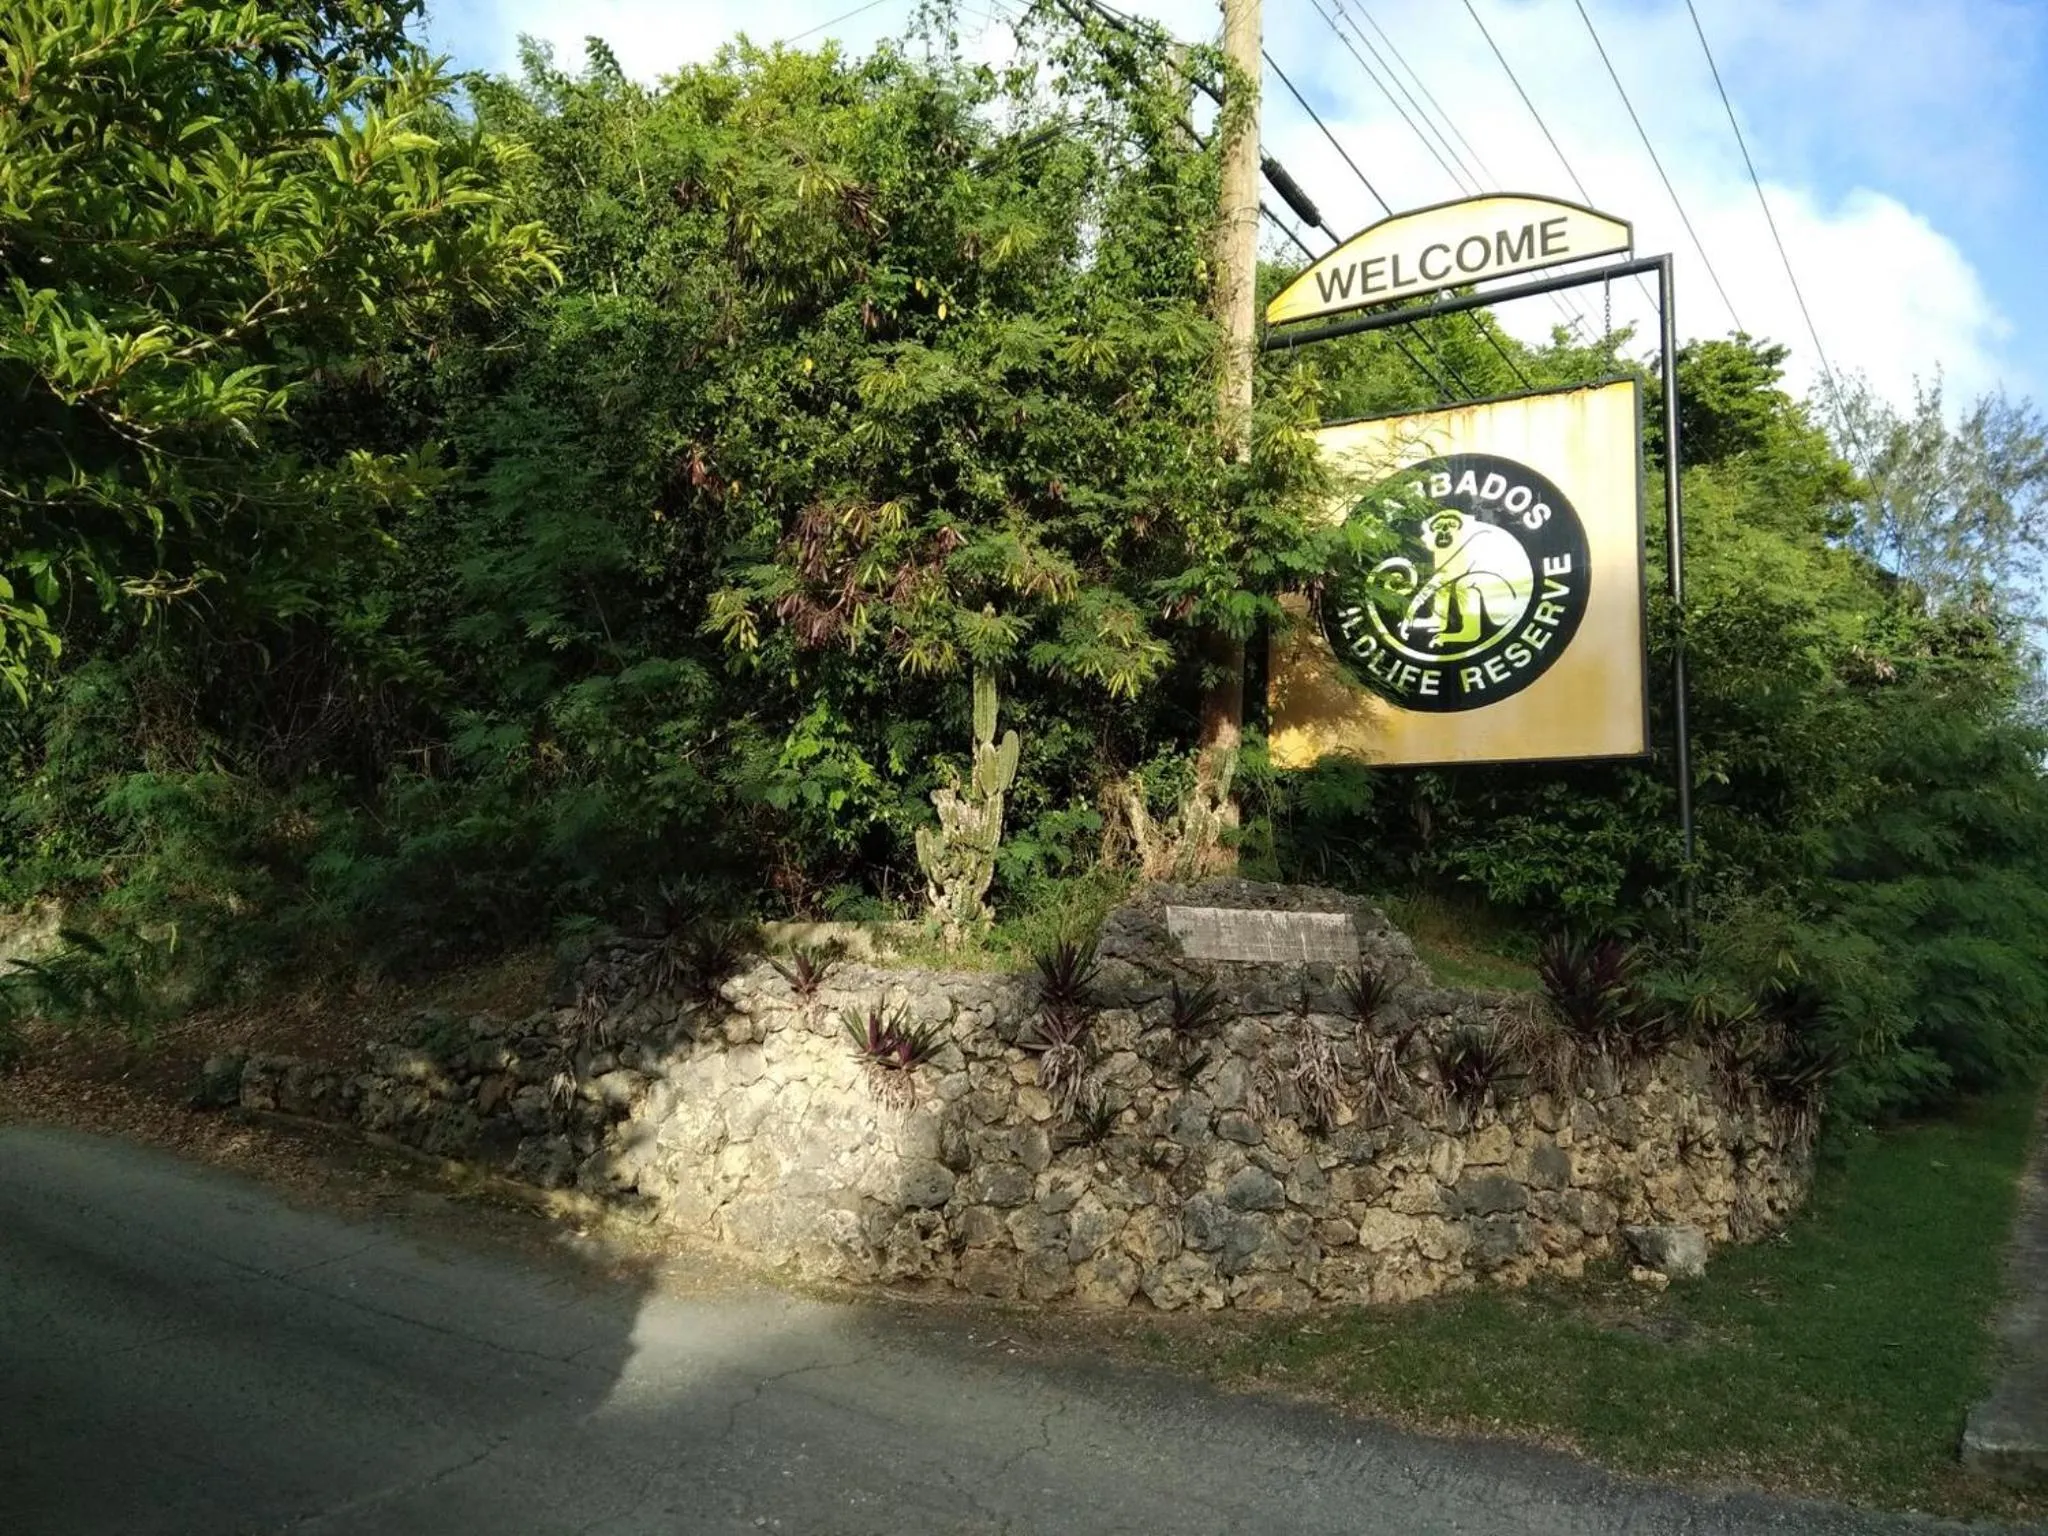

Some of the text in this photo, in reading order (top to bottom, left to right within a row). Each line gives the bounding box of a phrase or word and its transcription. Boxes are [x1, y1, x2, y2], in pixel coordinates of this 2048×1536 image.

[1315, 217, 1570, 303] WELCOME
[1383, 470, 1552, 530] RBADOS
[1337, 553, 1572, 696] ILDLIFE RESERVE
